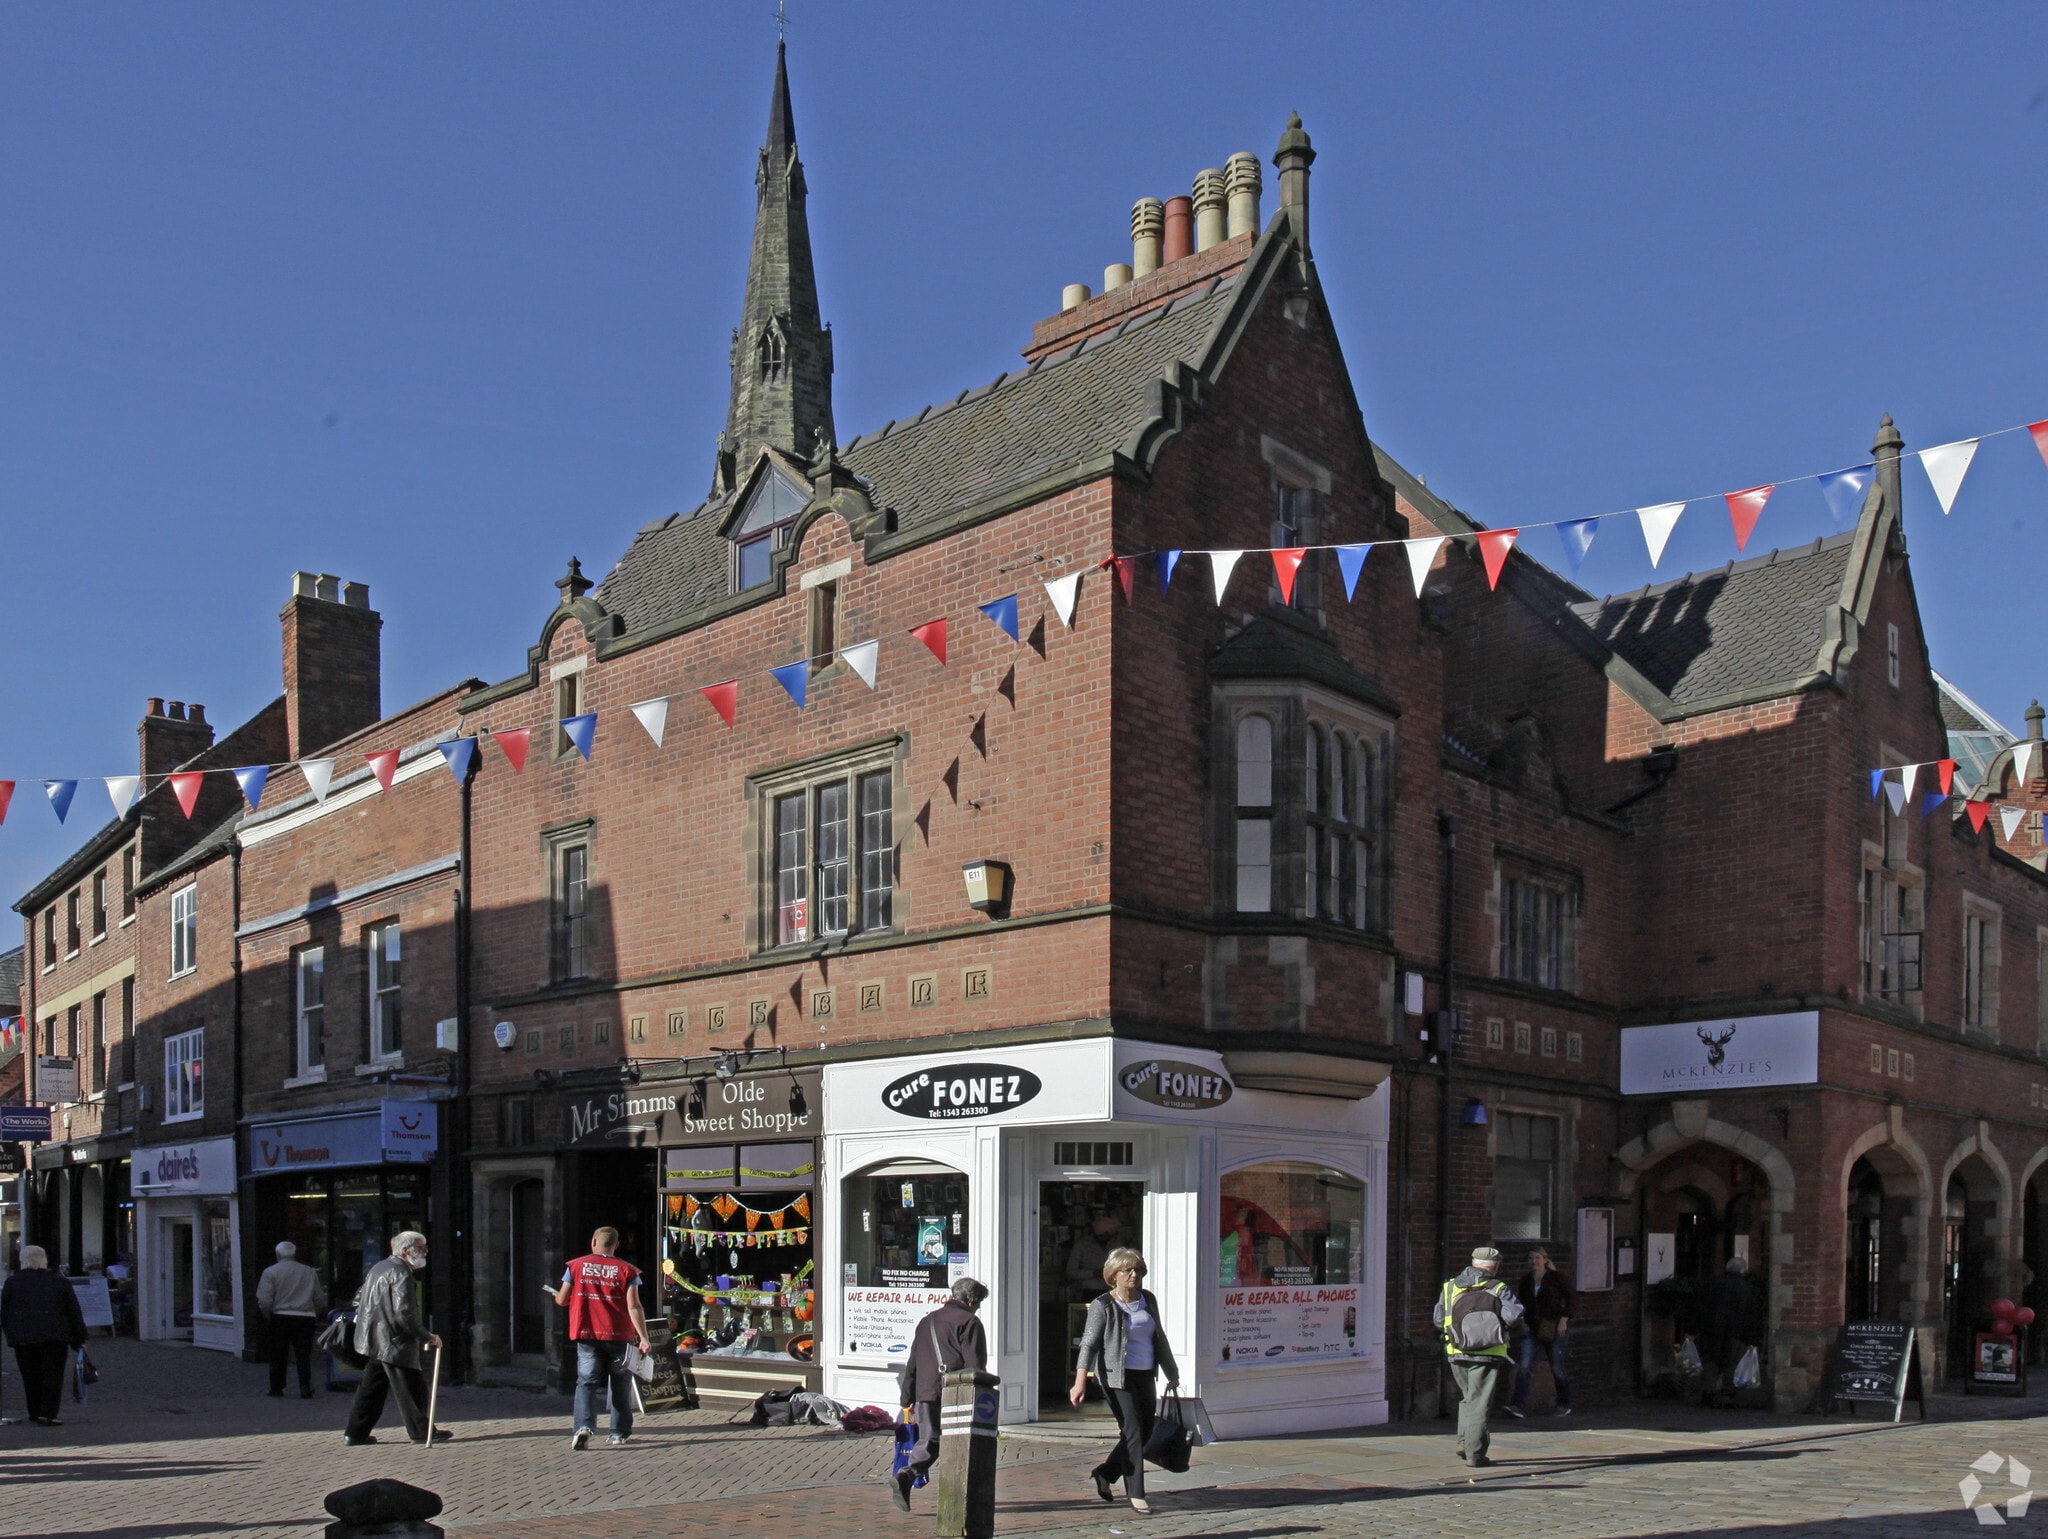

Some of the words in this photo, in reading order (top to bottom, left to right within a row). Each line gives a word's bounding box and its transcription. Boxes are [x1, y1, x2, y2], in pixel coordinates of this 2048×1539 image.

[968, 870, 980, 880] E11
[813, 969, 988, 1017] BANK
[889, 1073, 931, 1107] Cure
[932, 1075, 1021, 1107] FONEZ
[1126, 1062, 1160, 1090] Cure
[1160, 1071, 1223, 1101] FONEZ
[722, 1080, 766, 1104] Olde
[570, 1100, 601, 1144] Mr
[607, 1093, 677, 1122] Simms
[928, 1109, 942, 1118] Tel:
[942, 1109, 960, 1117] 1543
[961, 1107, 989, 1116] 263300
[5, 1118, 20, 1126] The
[22, 1118, 48, 1126] Works
[684, 1112, 735, 1134] Sweet
[391, 1130, 432, 1141] Thomson
[284, 1145, 330, 1163] Thomson
[847, 1291, 863, 1302] WE
[866, 1291, 902, 1304] REPAIR
[904, 1293, 924, 1304] ALL
[1225, 1292, 1244, 1306] WE
[1248, 1290, 1289, 1306] REPAIR
[1292, 1290, 1313, 1303] ALL
[1317, 1288, 1358, 1302] PHONES
[1235, 1346, 1259, 1355] NOKIA
[641, 1383, 682, 1397] Shoppe
